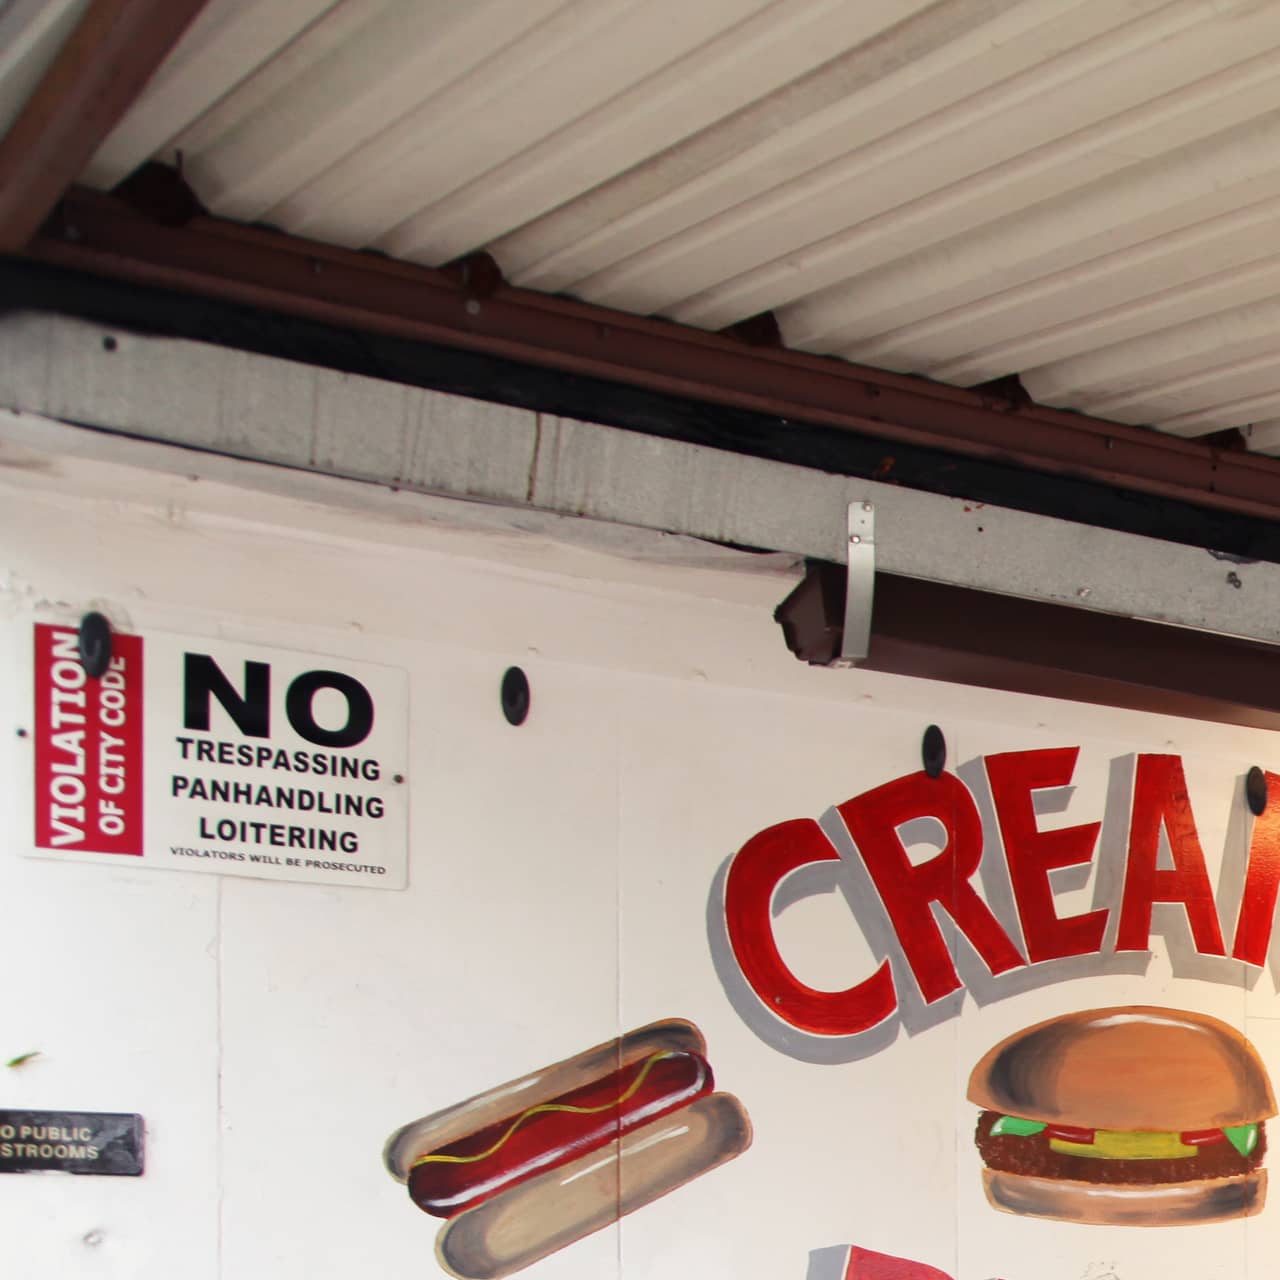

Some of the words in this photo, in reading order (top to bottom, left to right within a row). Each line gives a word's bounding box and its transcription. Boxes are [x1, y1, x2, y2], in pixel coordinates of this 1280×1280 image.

[100, 655, 126, 727] CODE
[183, 652, 374, 748] NO
[50, 631, 86, 846] VIOLATION
[176, 737, 380, 781] TRESPASSING
[99, 731, 125, 794] CITY
[100, 799, 125, 836] OF
[172, 775, 384, 818] PANHANDLING
[199, 817, 359, 853] LOITERING
[170, 847, 245, 862] VIOLATORS
[249, 854, 281, 865] WILL
[286, 857, 301, 867] BE
[305, 859, 386, 875] PROSECUTED
[21, 1125, 92, 1142] PUBLIC
